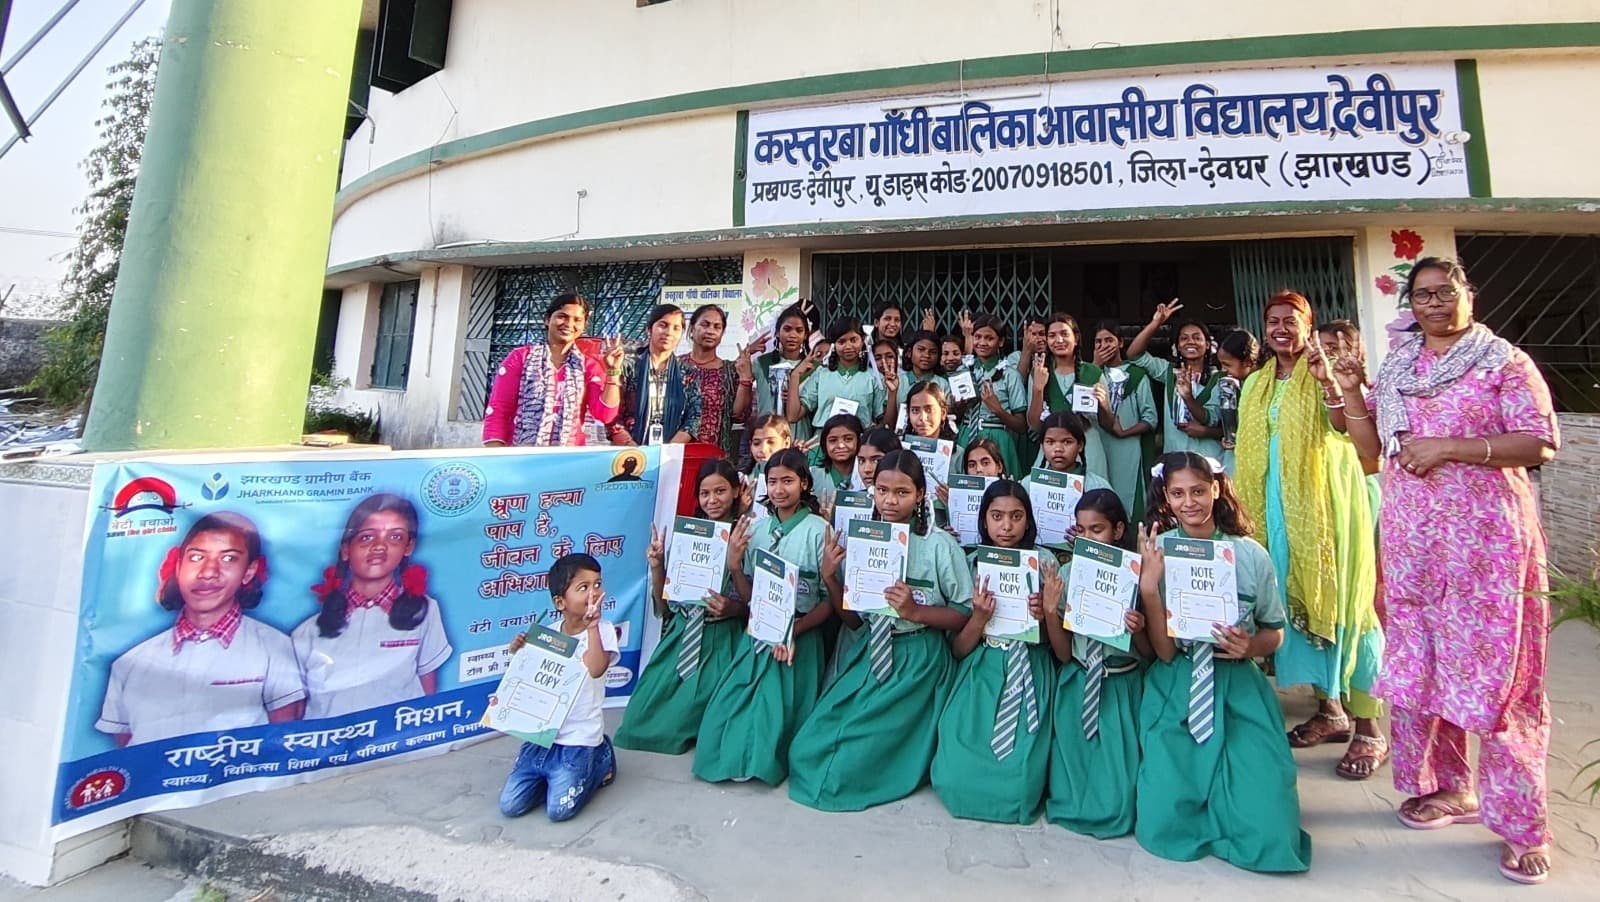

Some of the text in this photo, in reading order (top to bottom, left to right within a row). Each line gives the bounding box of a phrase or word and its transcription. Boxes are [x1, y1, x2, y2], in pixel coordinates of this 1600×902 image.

[754, 122, 867, 170] कस्तूरबा
[869, 105, 932, 157] गाँधी
[932, 101, 1037, 155] बालिका
[1038, 86, 1179, 146] आवासीय
[1327, 73, 1441, 145] देवीपुर
[240, 475, 300, 485] झारखण्ड
[305, 471, 345, 485] ग्रामीण
[237, 486, 374, 499] JHARKHAND GRAMIN BANK
[1047, 491, 1065, 502] NOTE
[490, 488, 585, 519] भ्रूण हत्या
[1047, 501, 1066, 512] COPY
[485, 520, 525, 540] पाप
[480, 531, 625, 569] जीवन के लिए
[692, 541, 711, 553] NOTE
[869, 546, 889, 558] NOTE
[691, 552, 711, 564] COPY
[868, 558, 889, 569] COPY
[999, 571, 1020, 583] NOTE
[1096, 567, 1119, 584] NOTE
[1190, 566, 1215, 579] NOTE
[479, 570, 550, 597] अभिशा
[769, 580, 784, 595] NOTE
[999, 583, 1021, 595] COPY
[1094, 581, 1118, 596] COPY
[1191, 579, 1215, 592] COPY
[768, 590, 783, 606] COPY
[469, 620, 492, 633] बेटी
[540, 658, 566, 676] NOTE
[534, 671, 560, 689] COPY
[165, 700, 472, 768] राष्ट्रीय स्वास्थ्य मिशन,
[223, 761, 280, 779] चिकित्सा
[287, 757, 320, 771] शिक्षा
[328, 749, 350, 765] एवं
[356, 741, 399, 760] परिवार
[405, 729, 446, 748] कल्याण
